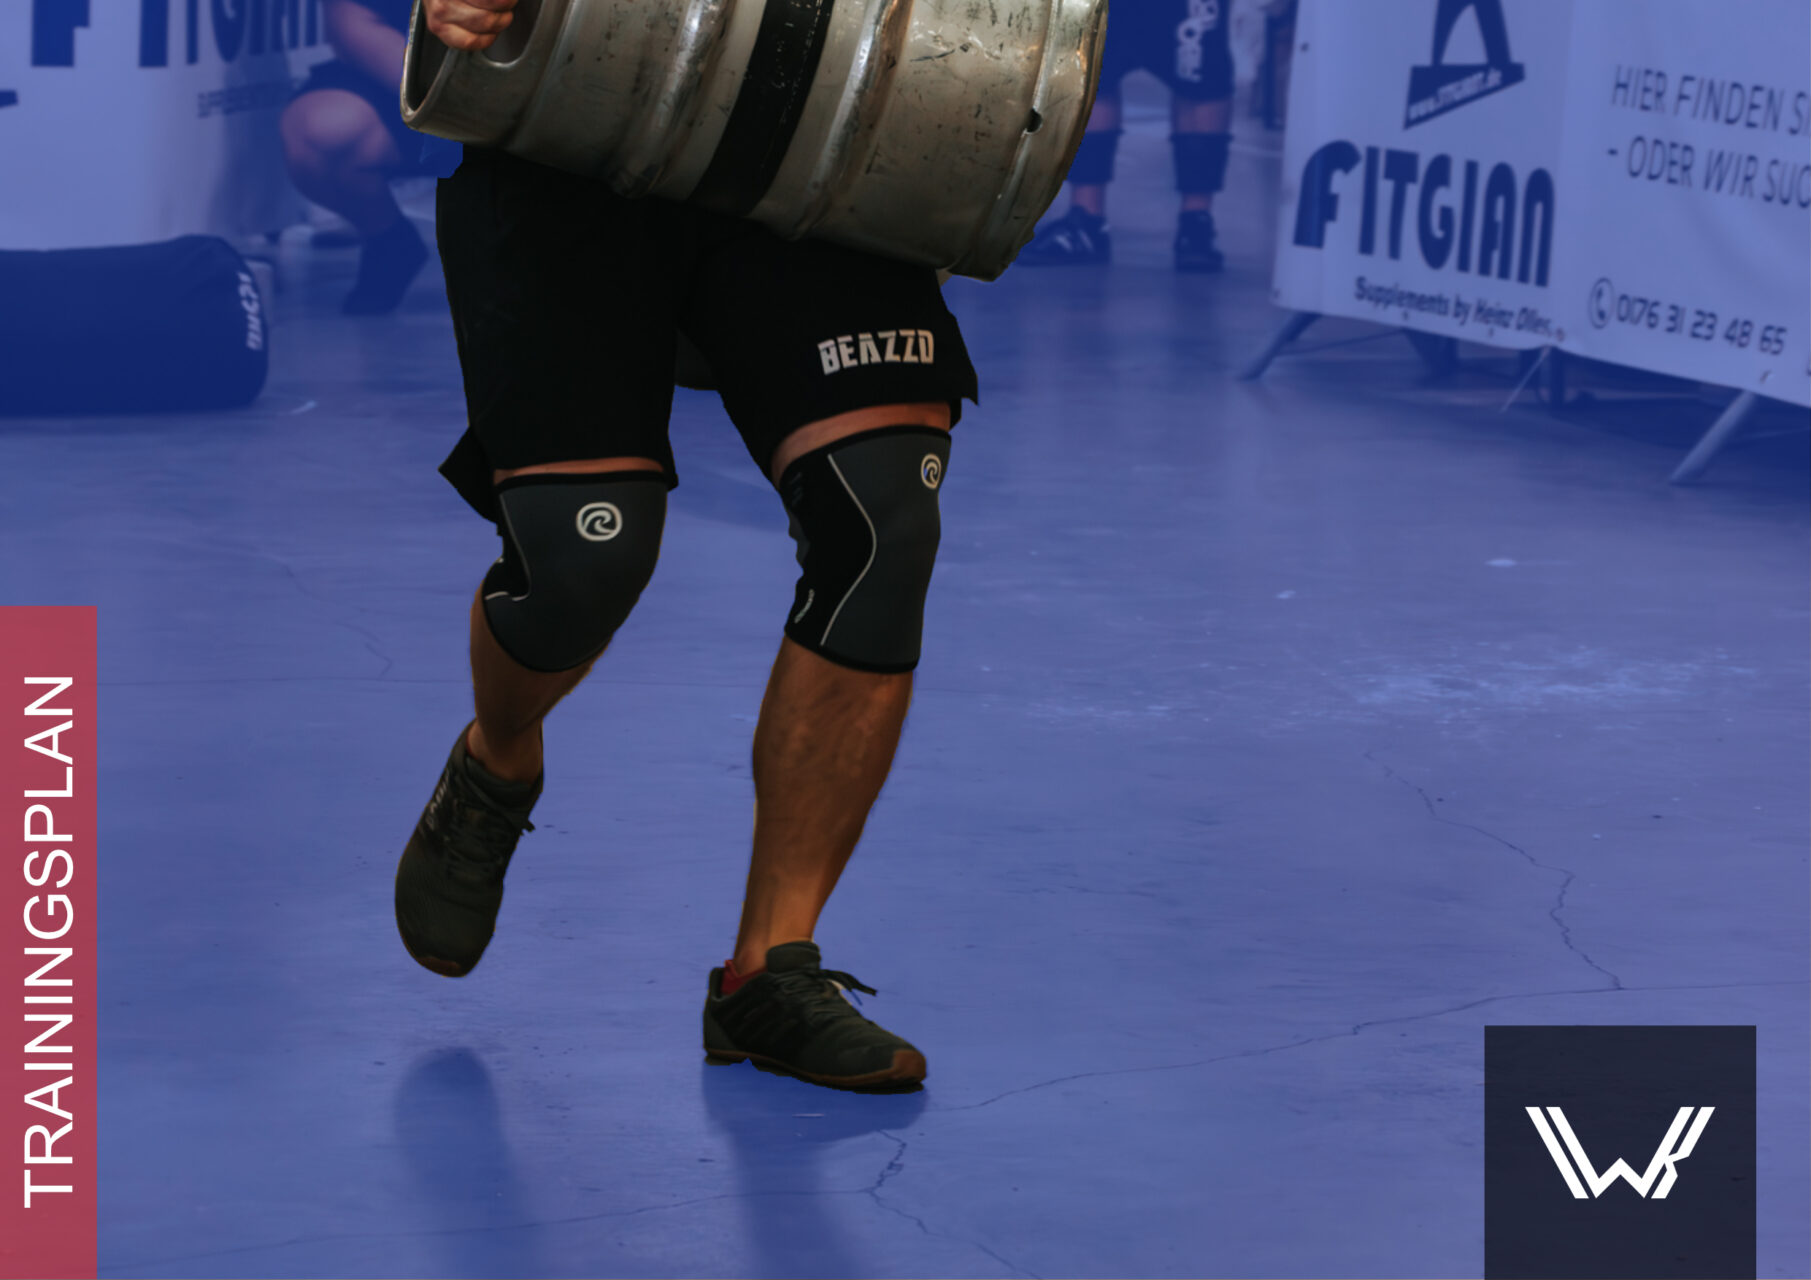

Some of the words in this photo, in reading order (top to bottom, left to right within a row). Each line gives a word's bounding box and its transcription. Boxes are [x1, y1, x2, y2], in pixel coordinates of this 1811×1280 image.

[1612, 66, 1668, 115] HIER
[1673, 74, 1784, 132] FINDEN
[1628, 135, 1695, 189] ODER
[1703, 148, 1759, 199] WIR
[1690, 309, 1717, 341] 23
[1724, 319, 1754, 349] 48
[1759, 325, 1787, 356] 65
